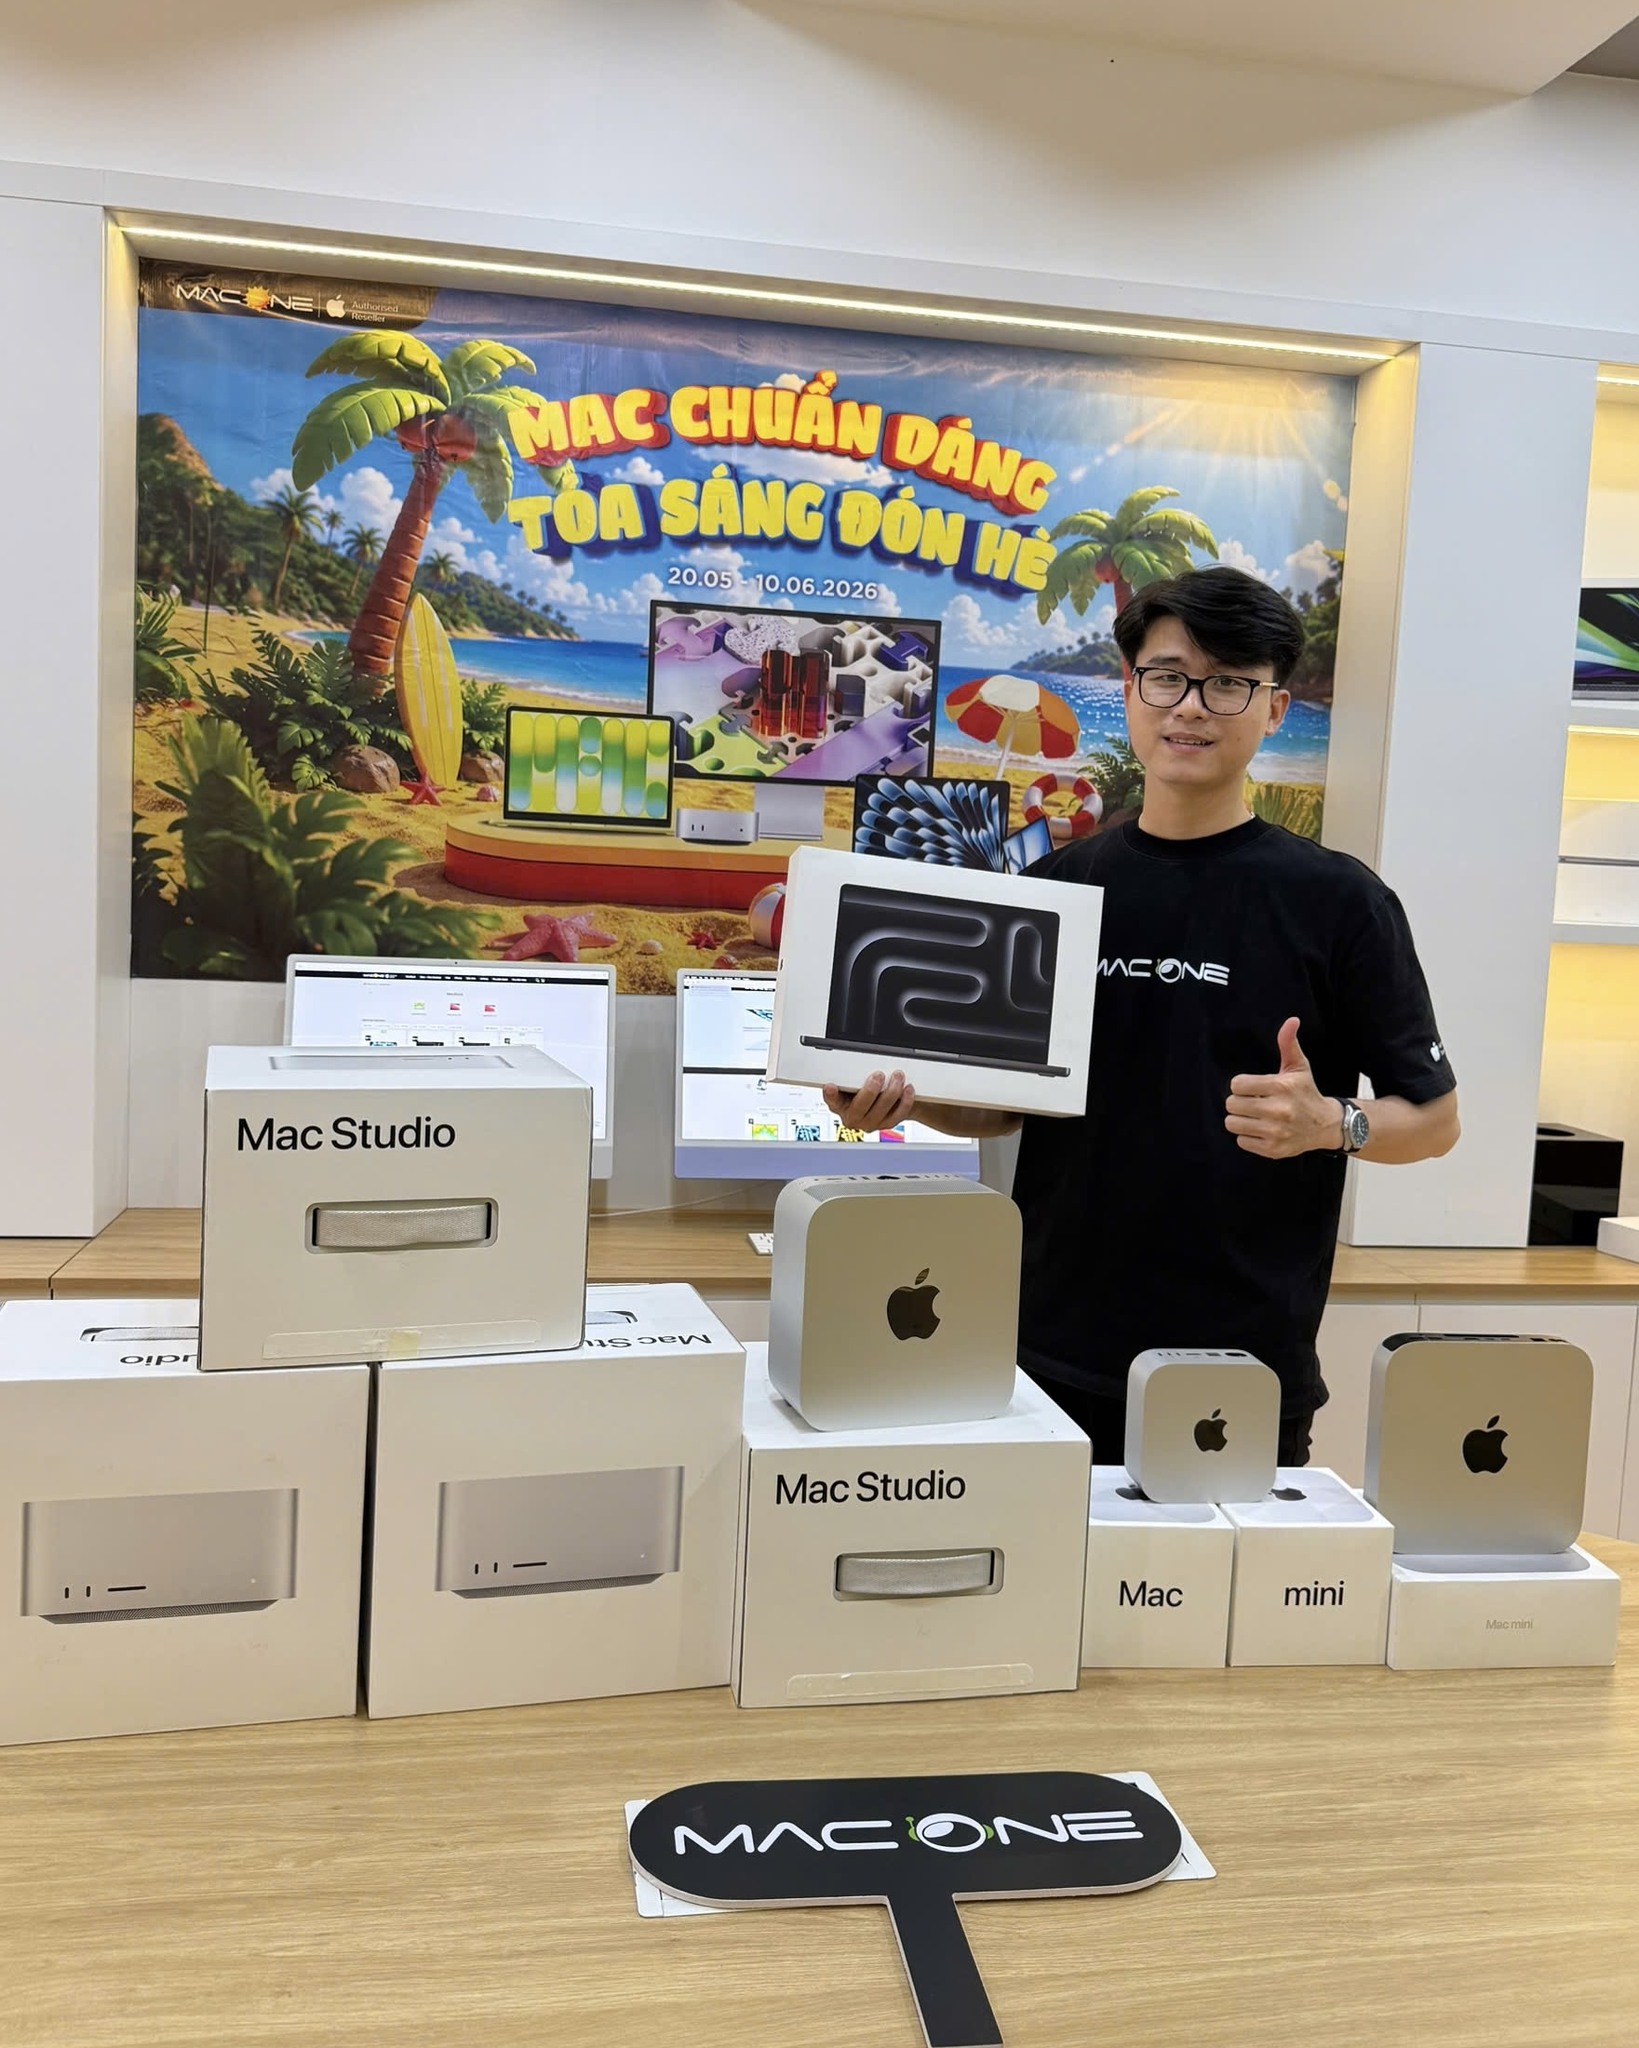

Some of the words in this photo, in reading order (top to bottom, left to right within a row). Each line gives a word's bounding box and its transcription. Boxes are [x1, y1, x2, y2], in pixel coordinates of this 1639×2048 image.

[352, 301, 399, 314] Authorised
[352, 313, 386, 324] Reseller
[507, 388, 655, 461] MAC
[670, 370, 882, 457] CHUẨN
[892, 417, 1058, 513] DÁNG
[660, 463, 825, 541] SÁNG
[838, 485, 965, 567] ĐÓN
[976, 522, 1058, 593] HÈ
[668, 567, 733, 589] 20.05
[756, 574, 879, 601] 10.06.2026
[237, 1118, 323, 1151] Mac
[331, 1117, 456, 1149] Studio
[775, 1474, 850, 1505] Mac
[856, 1470, 967, 1502] Studio
[1119, 1580, 1183, 1608] Mac
[1284, 1580, 1344, 1606] mini
[1486, 1619, 1509, 1630] Mac
[1511, 1618, 1533, 1630] mini
